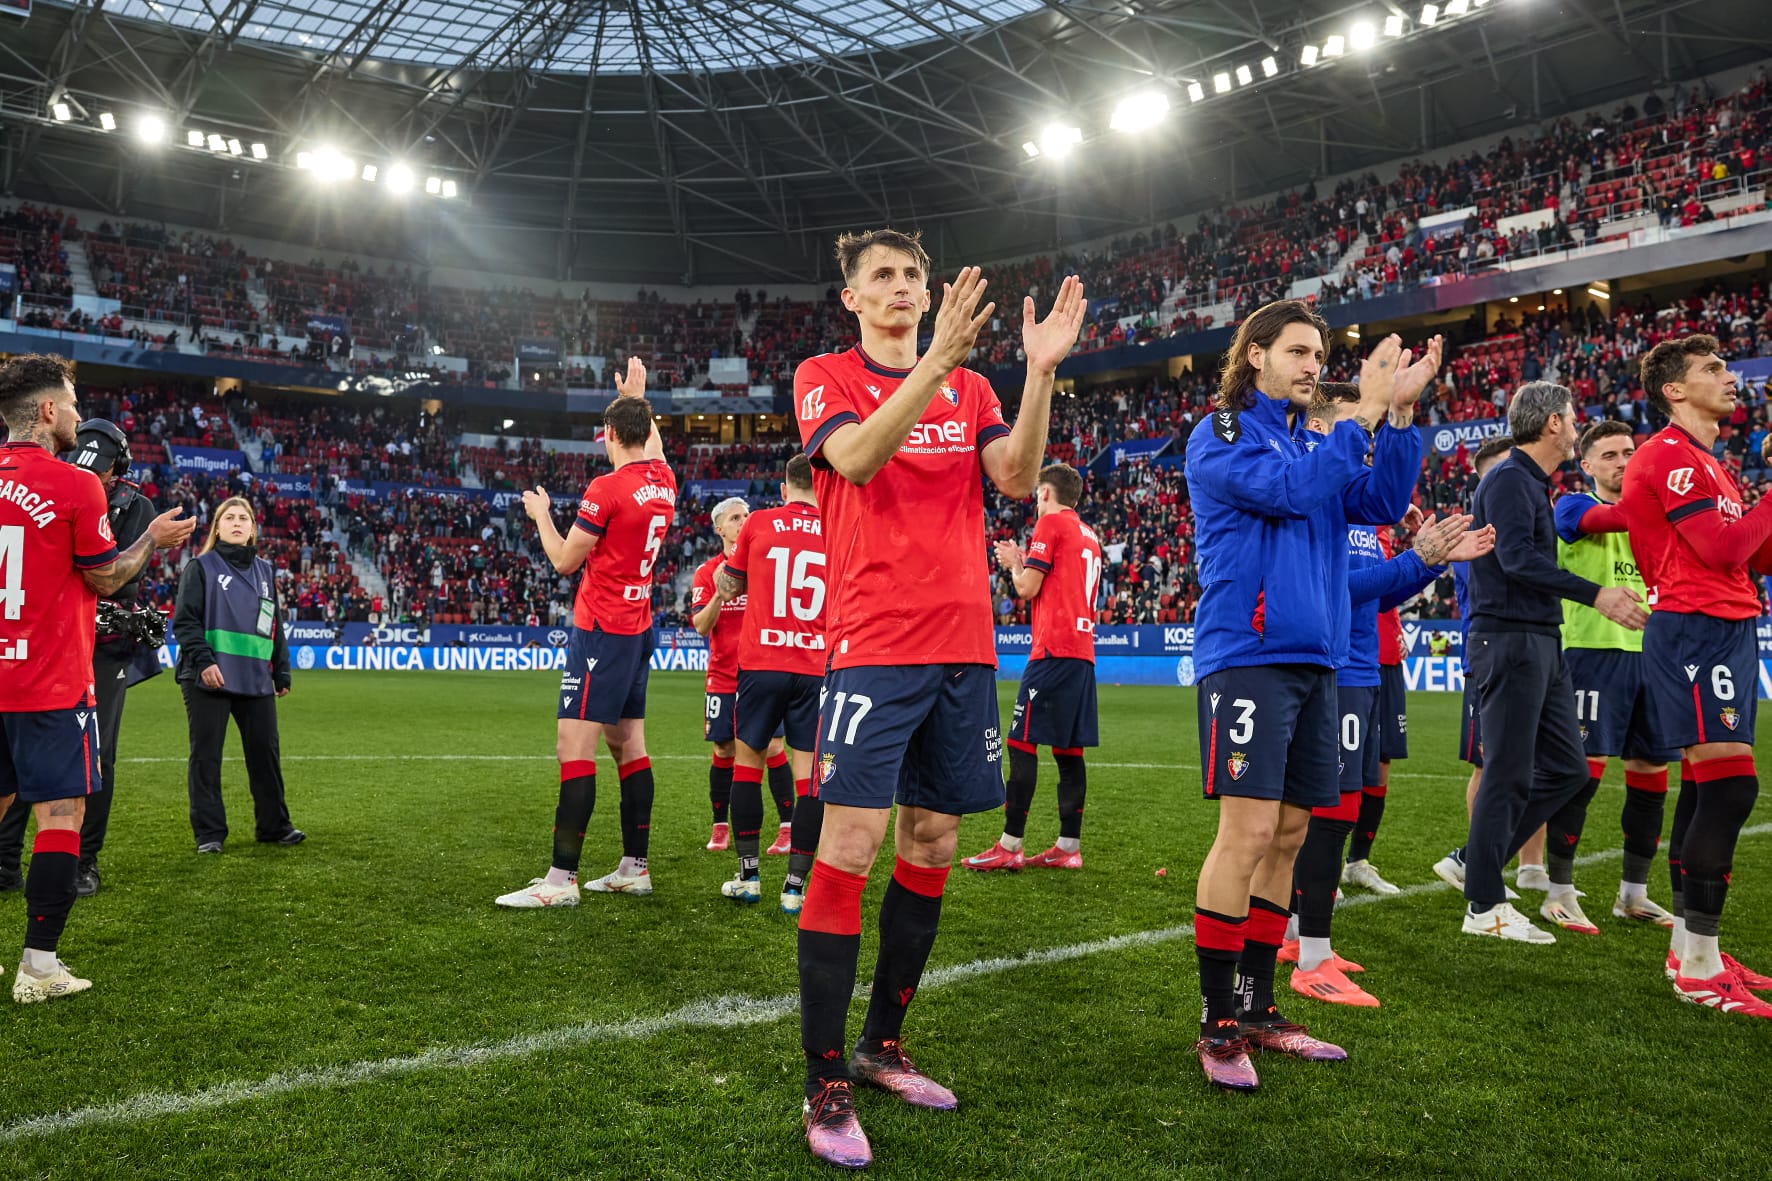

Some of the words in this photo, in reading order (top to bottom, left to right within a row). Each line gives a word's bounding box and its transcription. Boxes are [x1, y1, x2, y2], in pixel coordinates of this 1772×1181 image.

[0, 478, 57, 529] ARCÍA
[772, 518, 791, 533] R.
[640, 515, 666, 578] 5
[766, 546, 826, 621] 15
[478, 632, 513, 643] CaixaBank
[760, 628, 825, 650] DIGI
[998, 633, 1033, 645] PAMPLO
[326, 645, 425, 671] CLINICA
[1711, 664, 1736, 701] 6
[827, 691, 873, 745] 17
[1229, 698, 1257, 745] 3
[1574, 689, 1600, 721] 11
